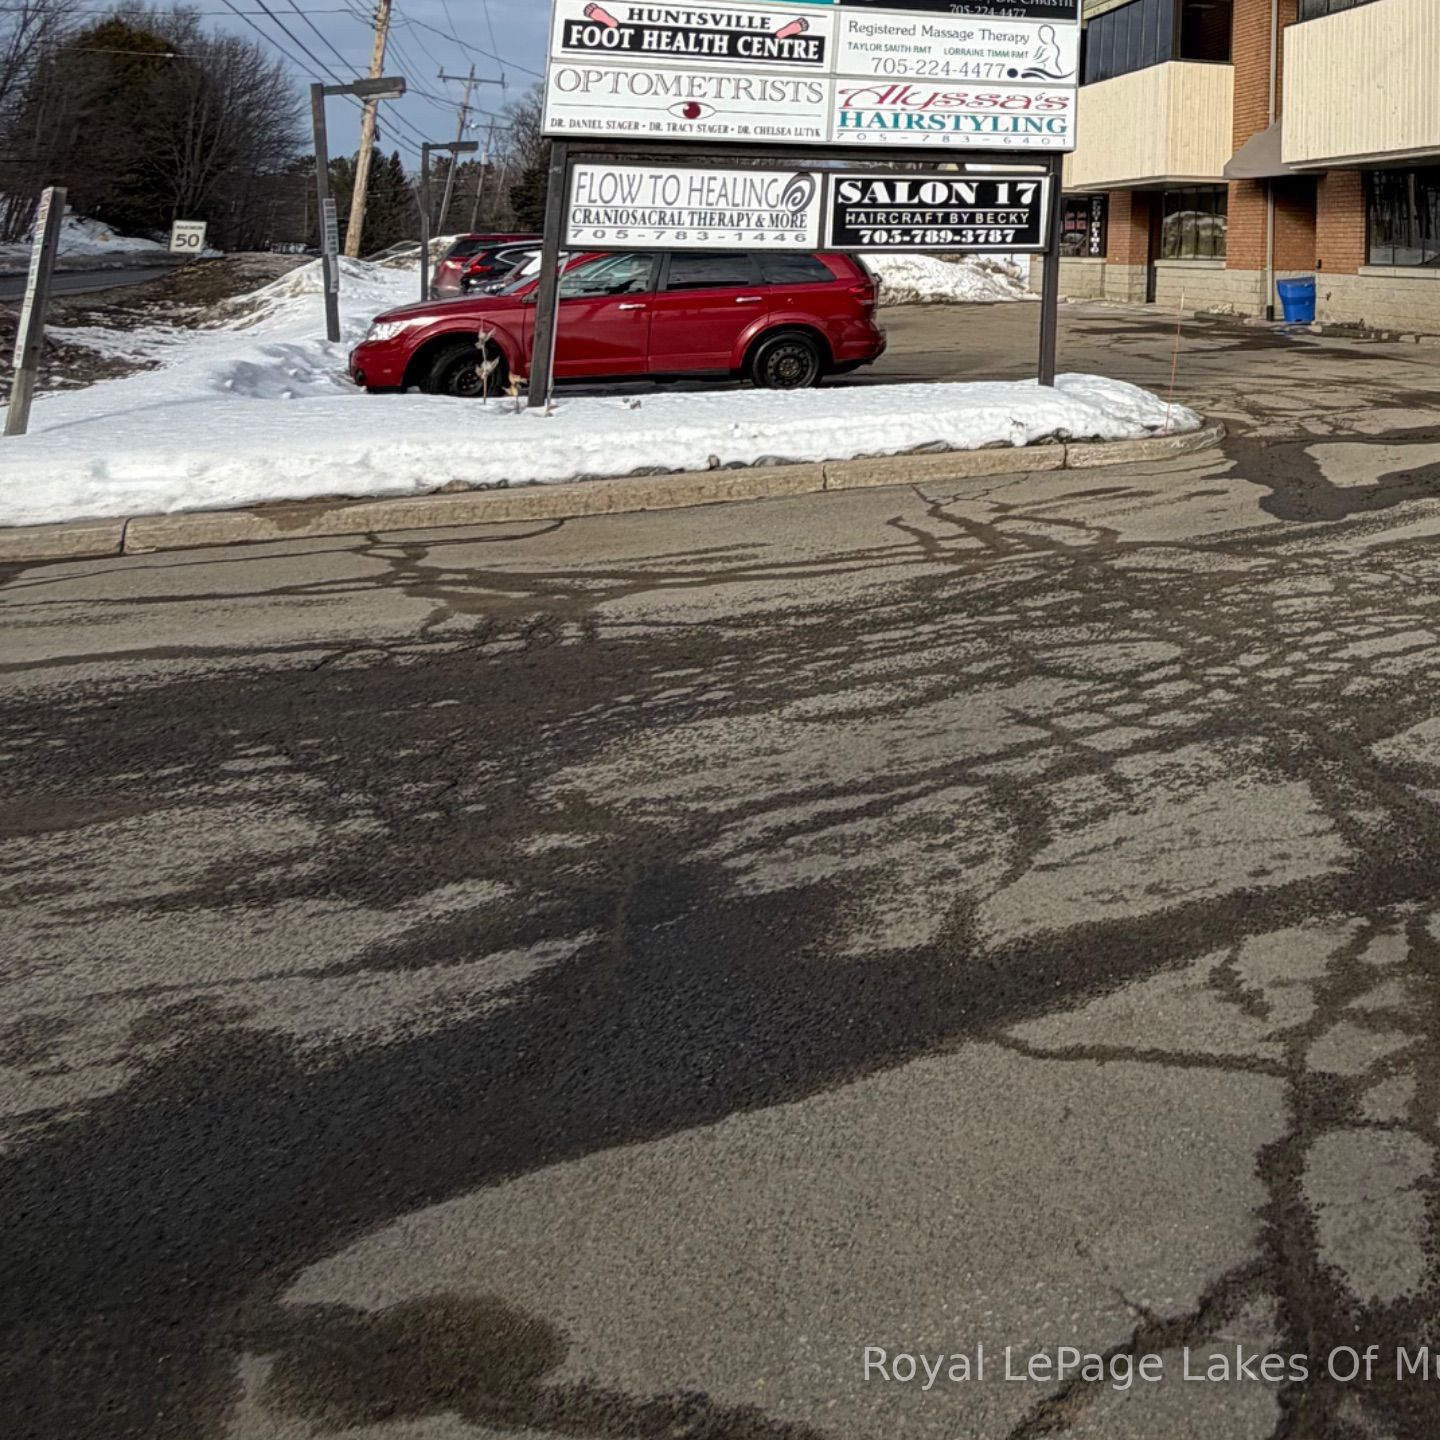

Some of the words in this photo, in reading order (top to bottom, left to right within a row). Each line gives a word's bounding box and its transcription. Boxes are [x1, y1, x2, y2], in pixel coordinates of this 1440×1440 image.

[627, 7, 771, 30] HUNTSVILLE
[569, 25, 635, 48] FOOT
[641, 28, 729, 54] HEALTH
[736, 35, 820, 60] CENTRE
[849, 20, 916, 37] Registered
[921, 25, 974, 42] Massage
[979, 28, 1030, 45] Therapy
[848, 41, 882, 52] TAYLOR
[884, 43, 911, 53] SMITH
[913, 45, 931, 54] RMT
[944, 47, 984, 57] LORRAINE
[987, 49, 1010, 58] TIMM
[871, 57, 1006, 79] 705-224-4477
[554, 68, 823, 104] OPTOMETRISTS
[569, 119, 603, 129] DANIEL
[605, 120, 640, 130] STAGER
[667, 122, 693, 133] TRACY
[697, 124, 729, 134] STAGER
[753, 126, 791, 136] CHELSEA
[839, 110, 1068, 134] HAIRSTYLING
[575, 171, 643, 204] FLOW
[649, 174, 681, 206] TO
[688, 176, 780, 209] HEALING
[838, 181, 979, 205] SALON
[995, 183, 1038, 205] 17
[572, 208, 684, 227] CRANIOSACRAL
[687, 211, 751, 228] THERAPY
[755, 214, 765, 228] &
[767, 213, 807, 229] MORE
[845, 212, 945, 224] HAIRCRAFT
[950, 213, 970, 224] BY
[975, 212, 1029, 225] BECKY
[175, 233, 200, 247] 50
[571, 229, 807, 243] 705-783-1446
[858, 229, 1016, 244] 705-789-3787
